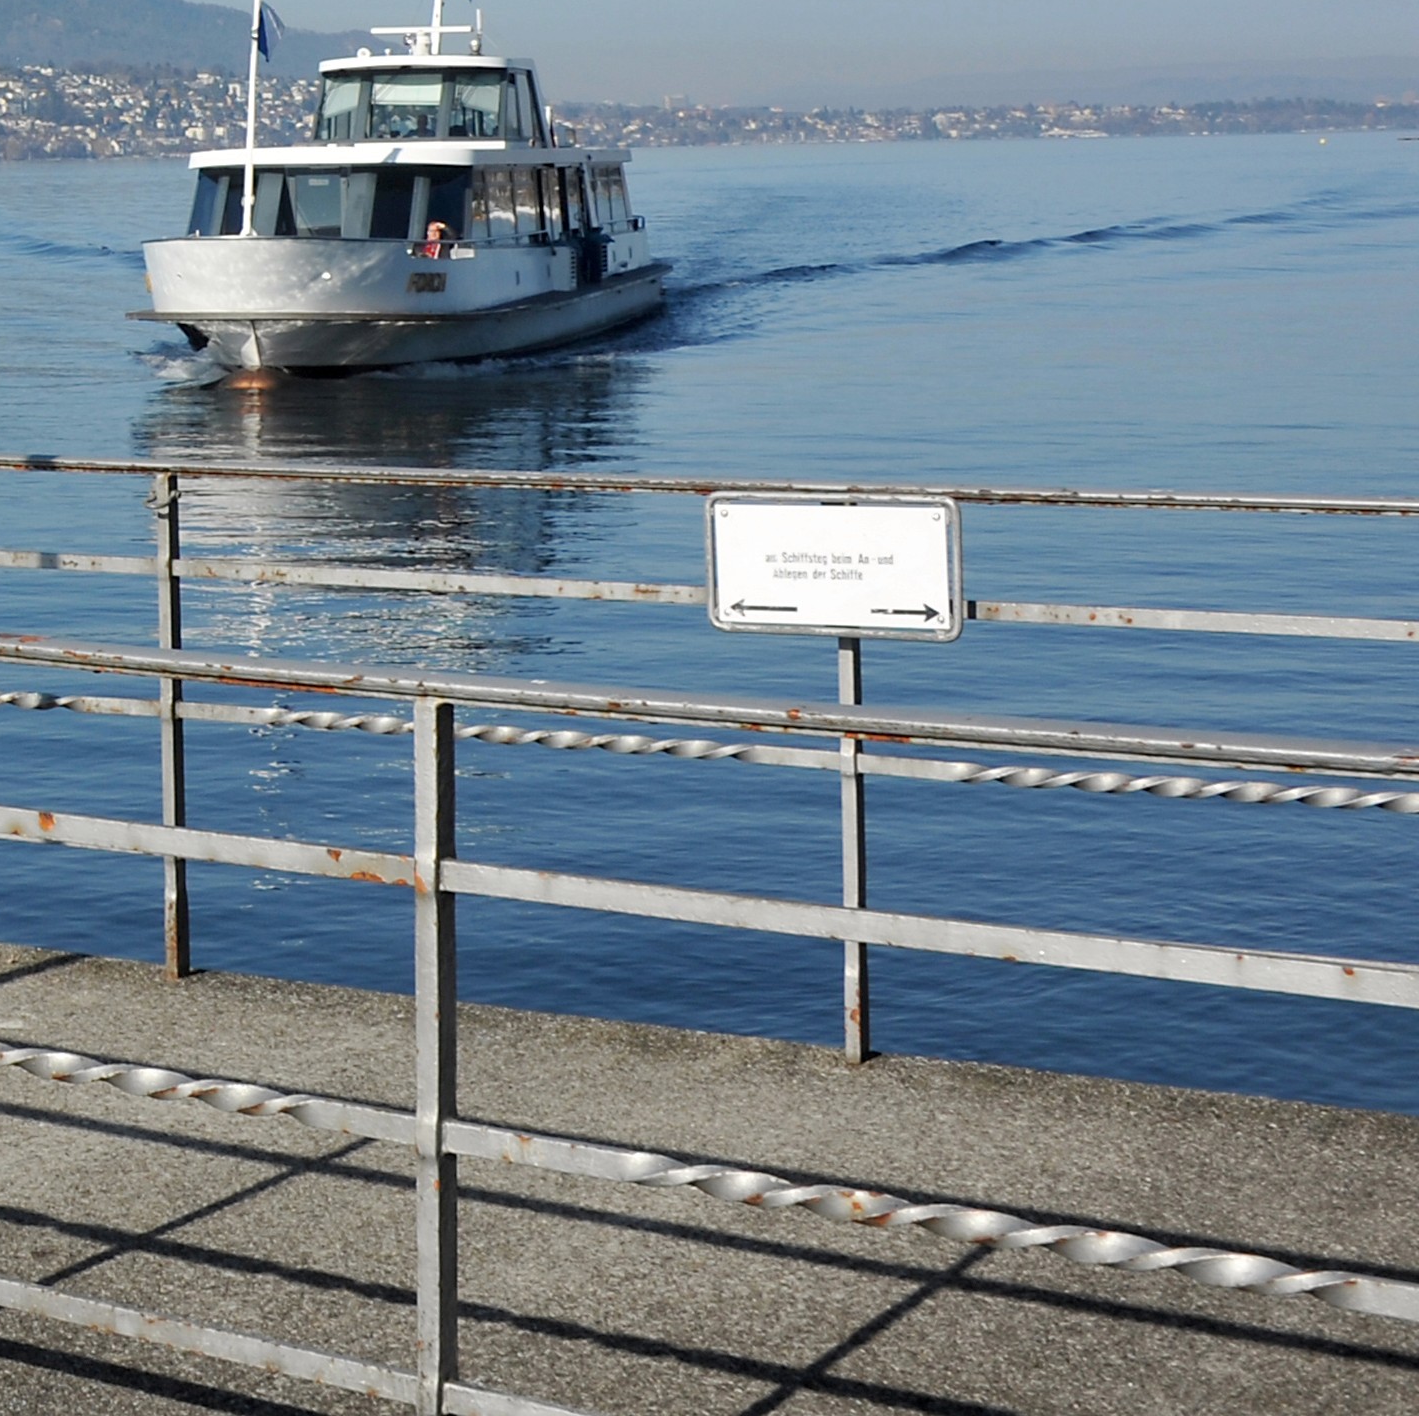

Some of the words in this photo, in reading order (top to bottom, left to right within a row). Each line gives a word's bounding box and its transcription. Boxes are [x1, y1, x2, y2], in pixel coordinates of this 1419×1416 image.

[782, 552, 827, 565] Schiffsteg
[831, 552, 852, 564] beim
[812, 568, 826, 579] der
[830, 568, 863, 580] Schiffe
